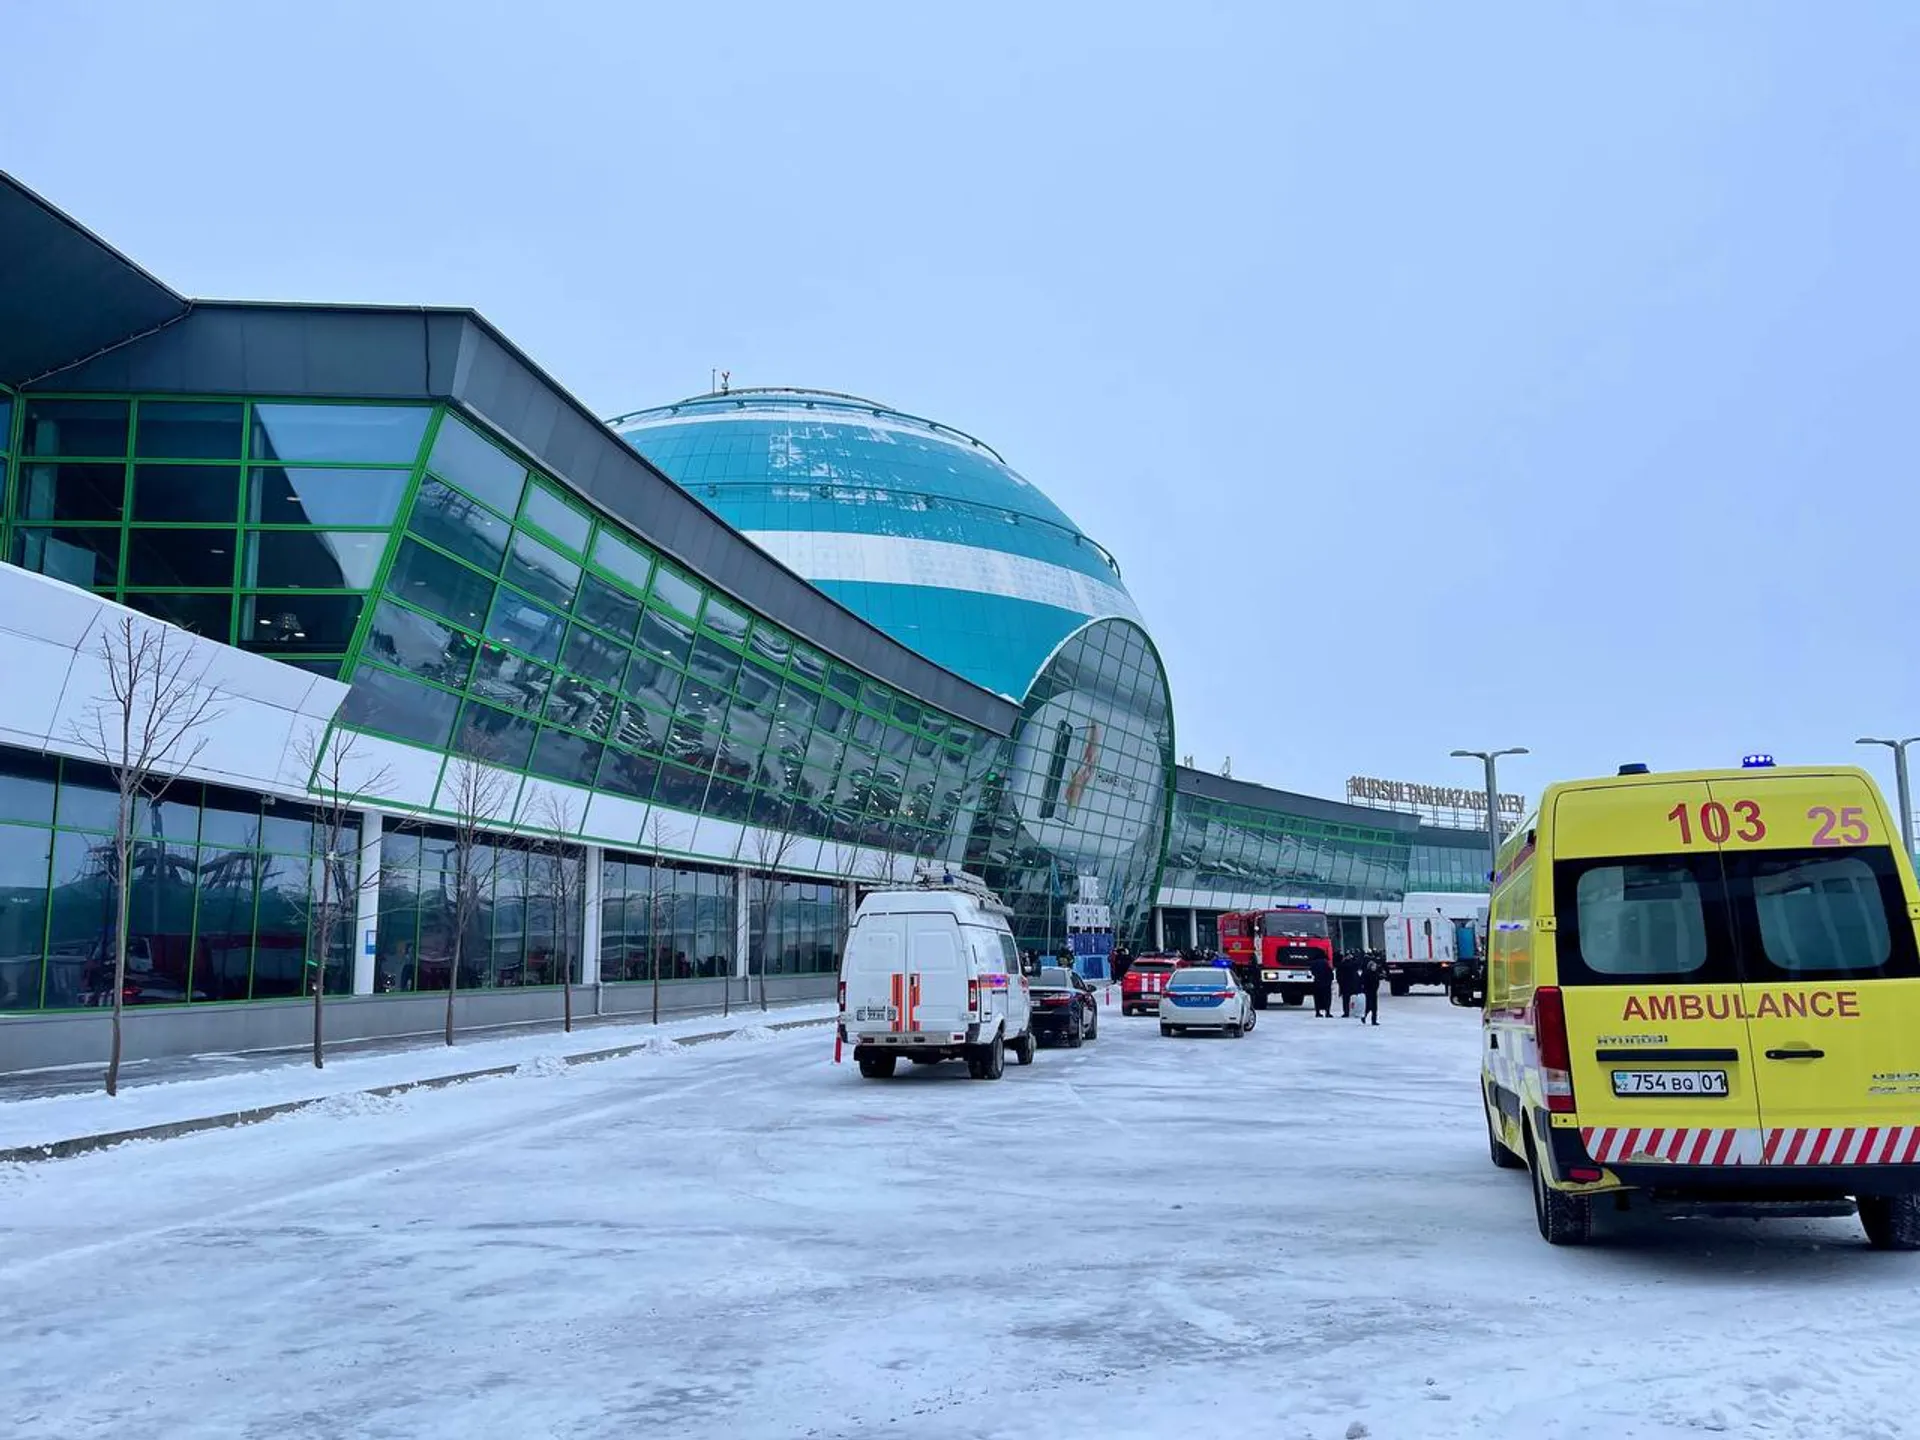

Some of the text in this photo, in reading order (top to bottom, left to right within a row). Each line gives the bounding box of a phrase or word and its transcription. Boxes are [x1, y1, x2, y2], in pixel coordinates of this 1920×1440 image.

[1435, 786, 1525, 813] NAZARBYEV
[1668, 800, 1766, 844] 103
[1807, 806, 1869, 845] 25
[1622, 991, 1860, 1021] AMBULANCE
[1632, 1074, 1666, 1090] 754
[1672, 1079, 1693, 1091] BQ
[1702, 1074, 1725, 1090] 01
